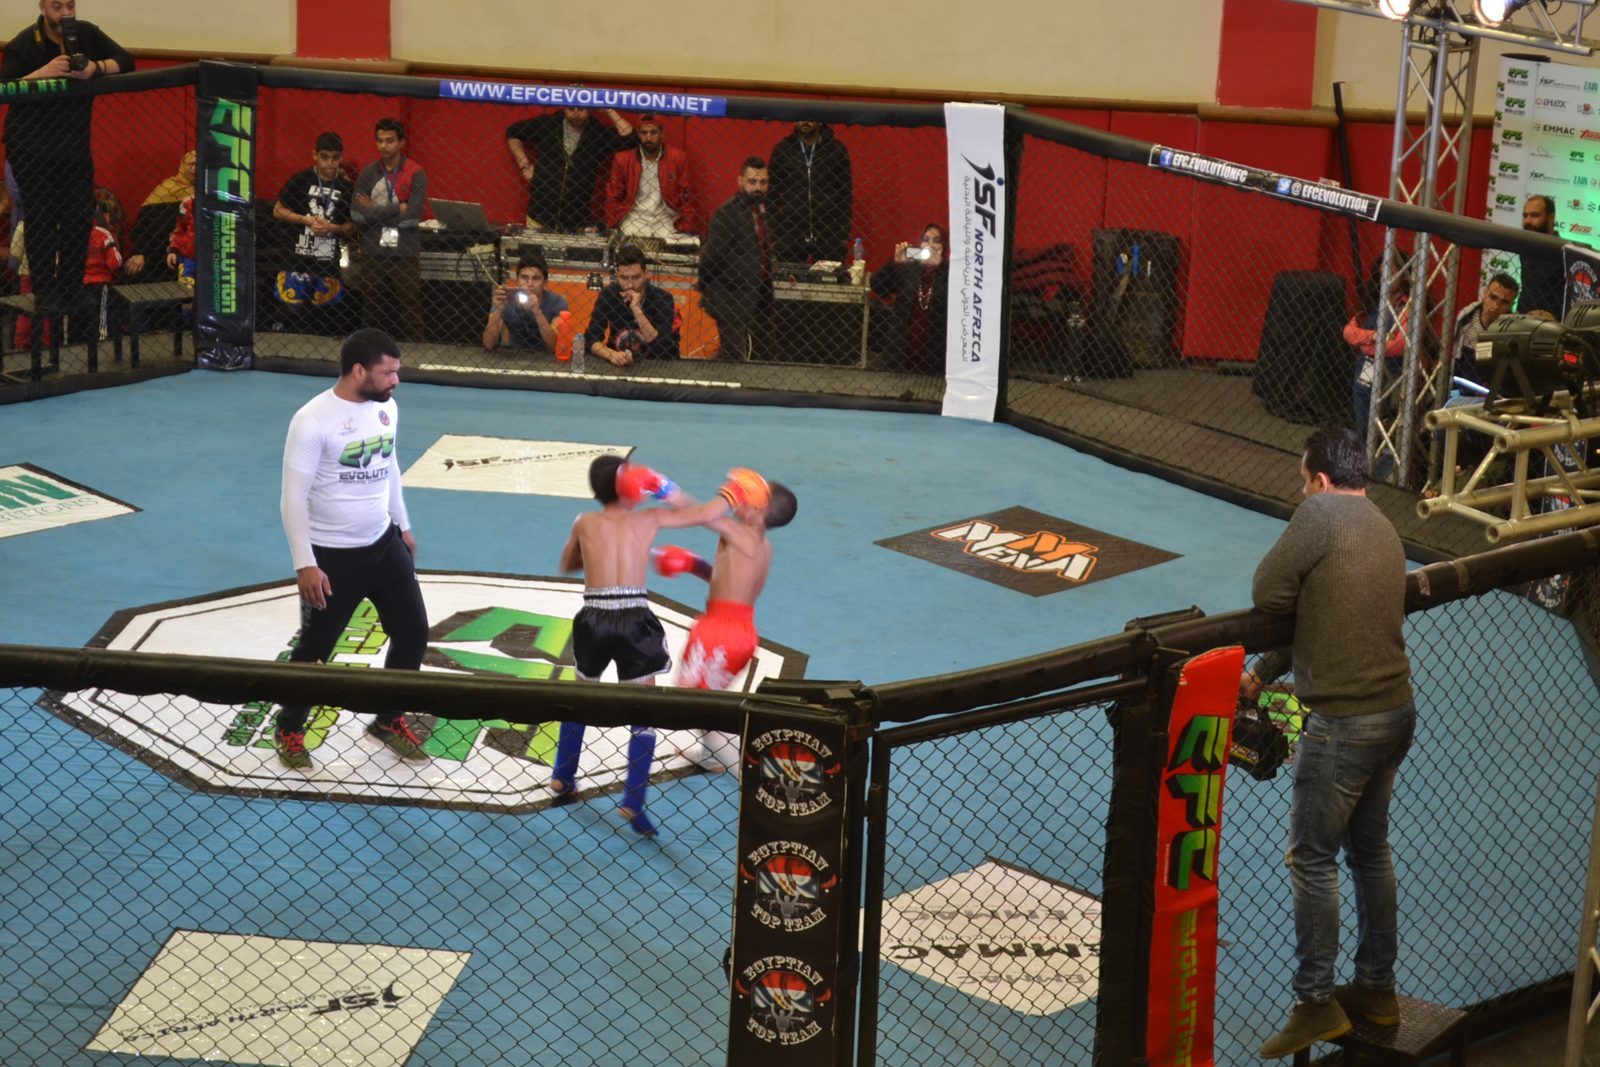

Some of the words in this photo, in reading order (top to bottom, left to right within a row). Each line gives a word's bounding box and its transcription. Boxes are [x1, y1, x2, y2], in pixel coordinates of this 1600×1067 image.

[450, 81, 712, 112] WWW.EFCEVOLUTION.NET
[1543, 124, 1576, 135] EMMAC
[220, 212, 237, 313] EVOLUTION
[973, 228, 984, 290] NORTH
[971, 292, 982, 363] AFRICA
[752, 728, 832, 758] EGYPTIAN
[756, 786, 786, 812] TOP
[788, 791, 832, 817] TEAM
[748, 840, 829, 871] EGYPTIAN
[751, 902, 781, 928] TOP
[784, 907, 827, 932] TEAM
[743, 955, 824, 986] EGYPTIAN
[746, 1016, 777, 1042] TOP
[779, 1020, 822, 1045] TEAM
